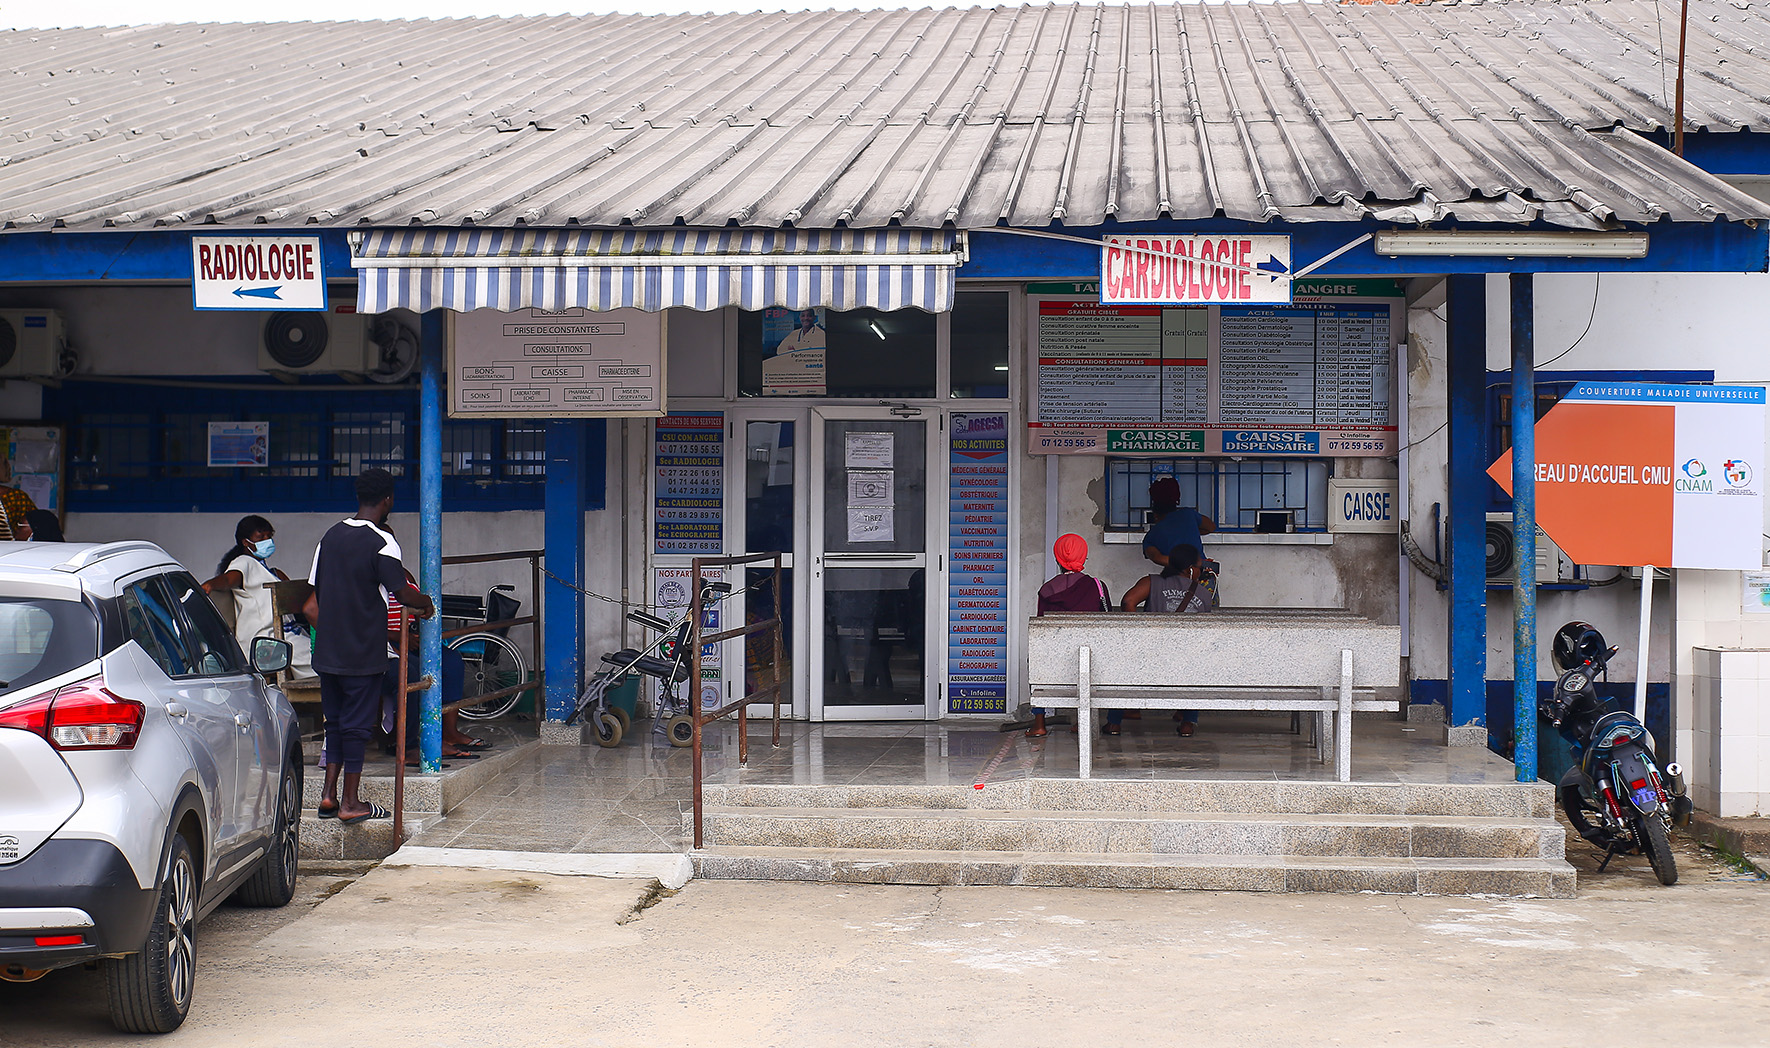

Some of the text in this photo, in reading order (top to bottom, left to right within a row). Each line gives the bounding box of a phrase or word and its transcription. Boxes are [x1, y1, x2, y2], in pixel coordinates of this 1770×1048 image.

[199, 244, 314, 280] RADIOLOGIE
[1107, 239, 1251, 299] CARDIOLOGIE
[1296, 284, 1358, 294] ANGRE
[765, 310, 789, 318] FBP
[514, 326, 600, 334] PRISE DE CONSTANTES
[532, 346, 584, 354] CONSULTATIONS
[1580, 387, 1759, 399] COUVERTURE MALADIE UNIVERSELLE
[1120, 431, 1192, 441] CAISSE
[1235, 432, 1306, 442] CAISSE
[669, 445, 677, 453] 07
[680, 445, 688, 453] 12
[690, 445, 698, 453] 59
[712, 445, 720, 453] 55
[953, 440, 1005, 449] NOS ACTIVITES
[1112, 441, 1200, 450] PHARMACIE
[1226, 442, 1316, 451] DISPENSAIRE
[1329, 441, 1384, 450] 07 12 59 56 55
[1642, 465, 1671, 485] CMU
[1675, 479, 1712, 491] CNAM
[1344, 492, 1391, 521] CAISSE
[952, 700, 1004, 709] 07 12 59 56 55
[1631, 790, 1657, 806] VIP
